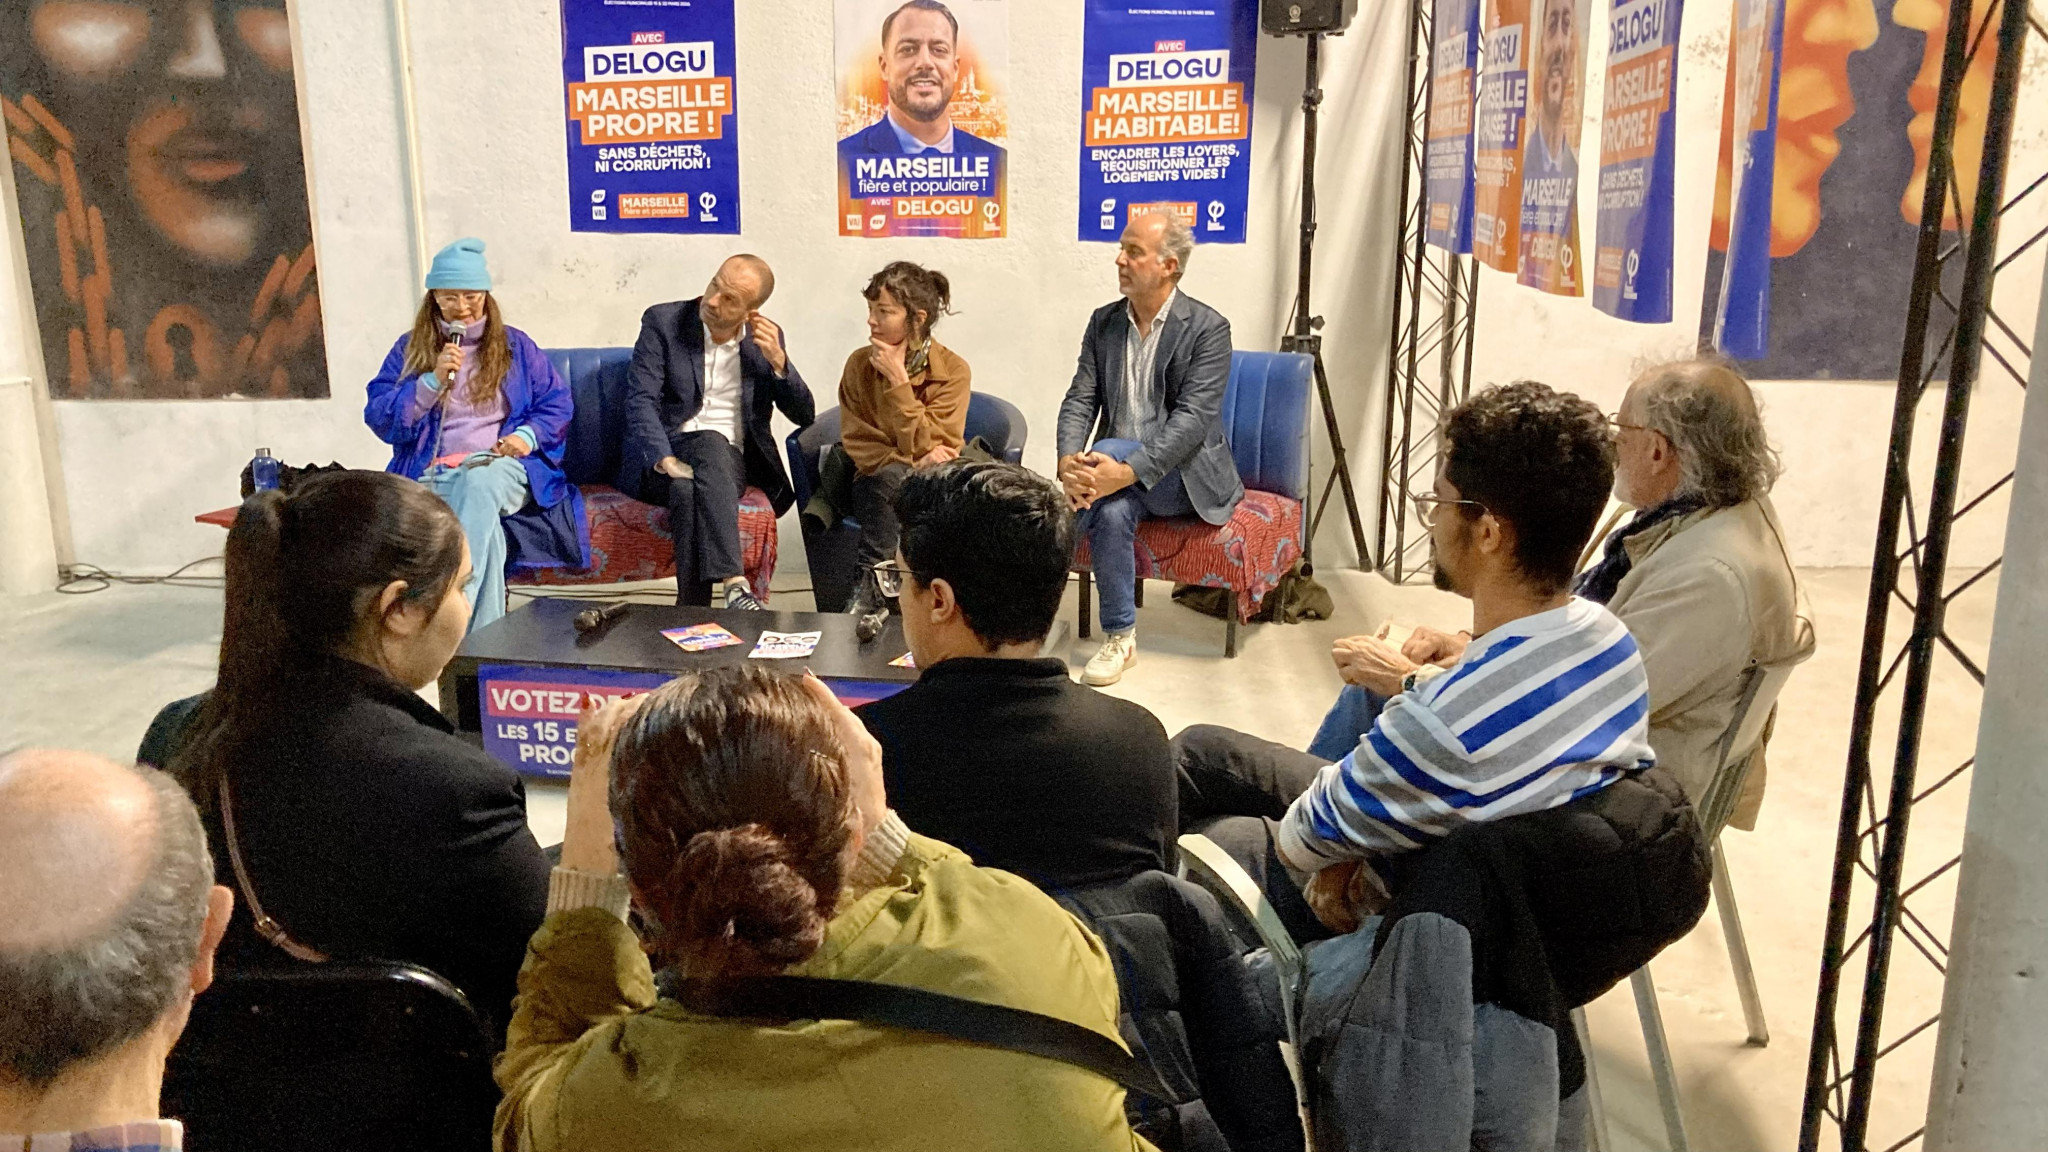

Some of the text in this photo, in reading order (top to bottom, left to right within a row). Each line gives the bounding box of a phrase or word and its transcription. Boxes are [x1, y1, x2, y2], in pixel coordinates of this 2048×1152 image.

[634, 33, 662, 44] AVEC
[1157, 42, 1183, 52] AVEC
[593, 50, 706, 76] DELOGU
[1117, 57, 1222, 81] DELOGU
[576, 84, 725, 112] MARSEILLE
[1099, 89, 1237, 115] MARSEILLE
[588, 110, 714, 137] PROPRE !
[1093, 113, 1240, 139] HABITABLE!
[598, 143, 707, 160] SANS DÉCHETS,
[1092, 144, 1240, 161] ENCADRER LES LOYERS,
[595, 157, 711, 173] NI CORRUPTION !
[856, 156, 989, 179] MARSEILLE
[1101, 156, 1230, 173] RÉQUISITIONNER LES
[1104, 168, 1226, 184] LOGEMENTS VIDES !
[858, 178, 986, 196] fière et populaire !
[1522, 178, 1573, 207] MARSEILLE
[622, 196, 685, 208] MARSEILLE
[897, 199, 973, 215] DELOGU
[491, 687, 581, 714] VOTEZ
[497, 723, 528, 741] LES
[533, 721, 560, 743] 15
